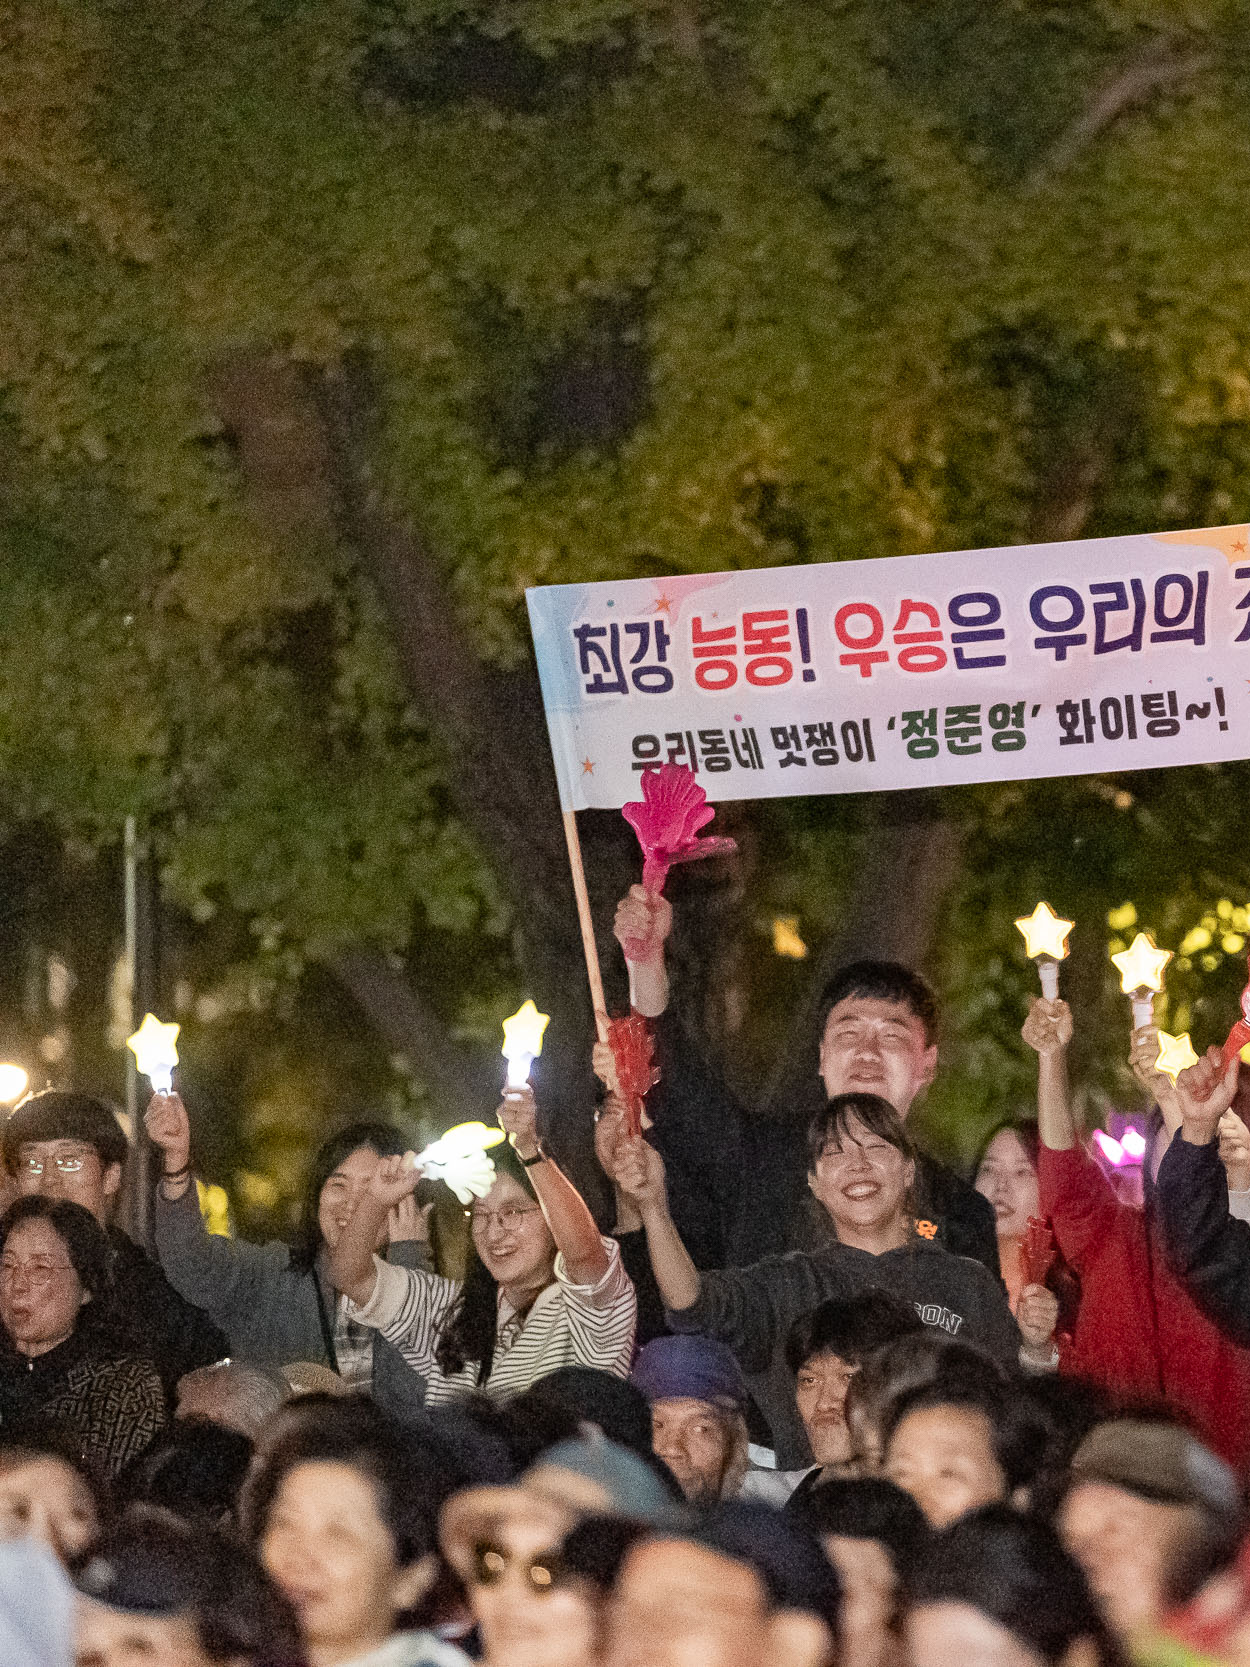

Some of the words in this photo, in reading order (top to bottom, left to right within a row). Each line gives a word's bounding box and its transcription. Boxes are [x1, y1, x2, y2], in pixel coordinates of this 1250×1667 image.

[573, 620, 674, 695] 최강
[692, 608, 816, 691] 능동!
[834, 592, 1006, 679] 우승은
[1029, 570, 1210, 662] 우리의
[631, 727, 765, 773] 우리동네
[770, 718, 876, 769] 멋쟁이
[1056, 687, 1229, 746] 화이팅~!
